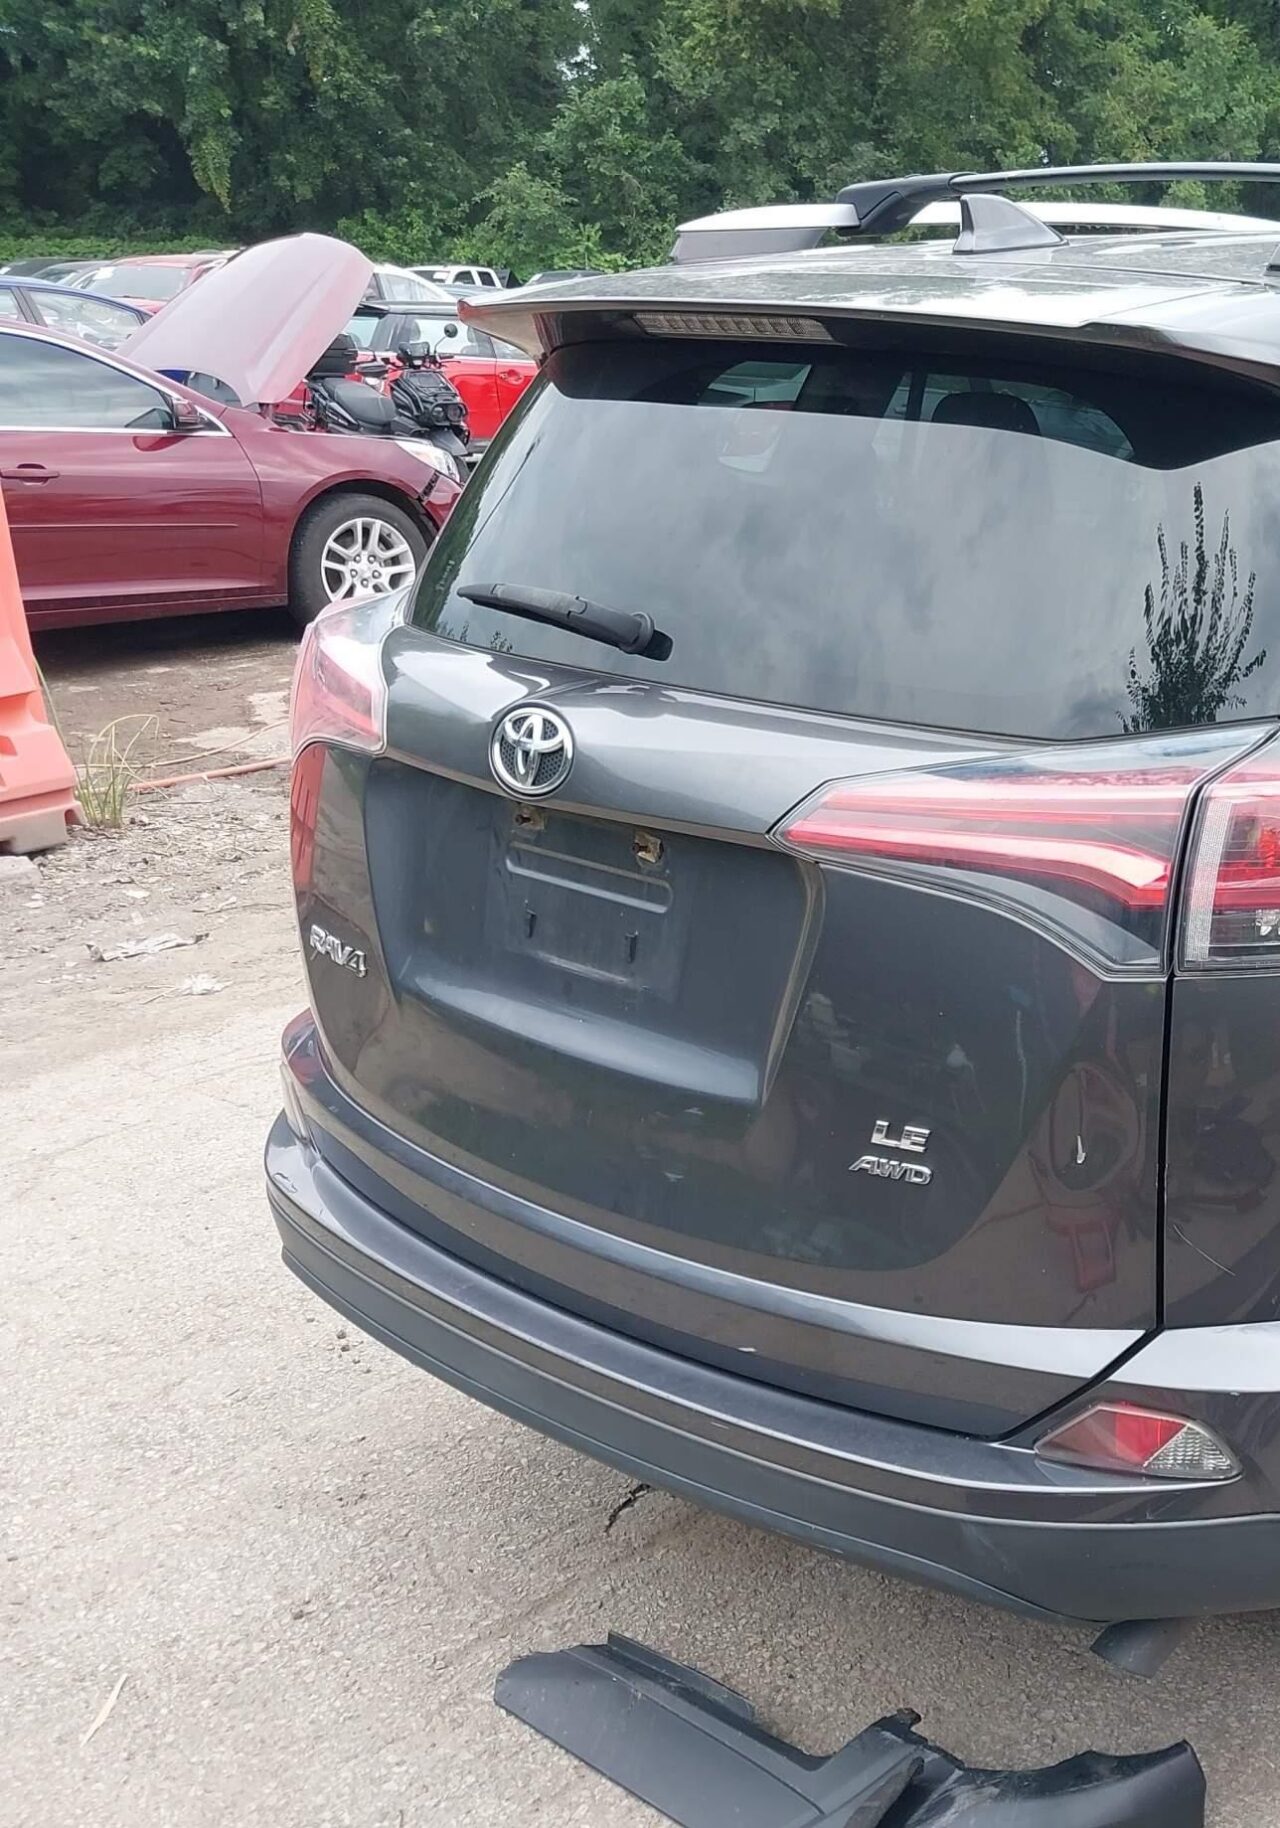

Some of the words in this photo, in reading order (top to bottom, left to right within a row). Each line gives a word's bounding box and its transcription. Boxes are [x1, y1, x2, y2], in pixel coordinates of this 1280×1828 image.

[309, 924, 367, 978] RAV4
[871, 1120, 931, 1153] LE
[848, 1155, 933, 1185] AWD
